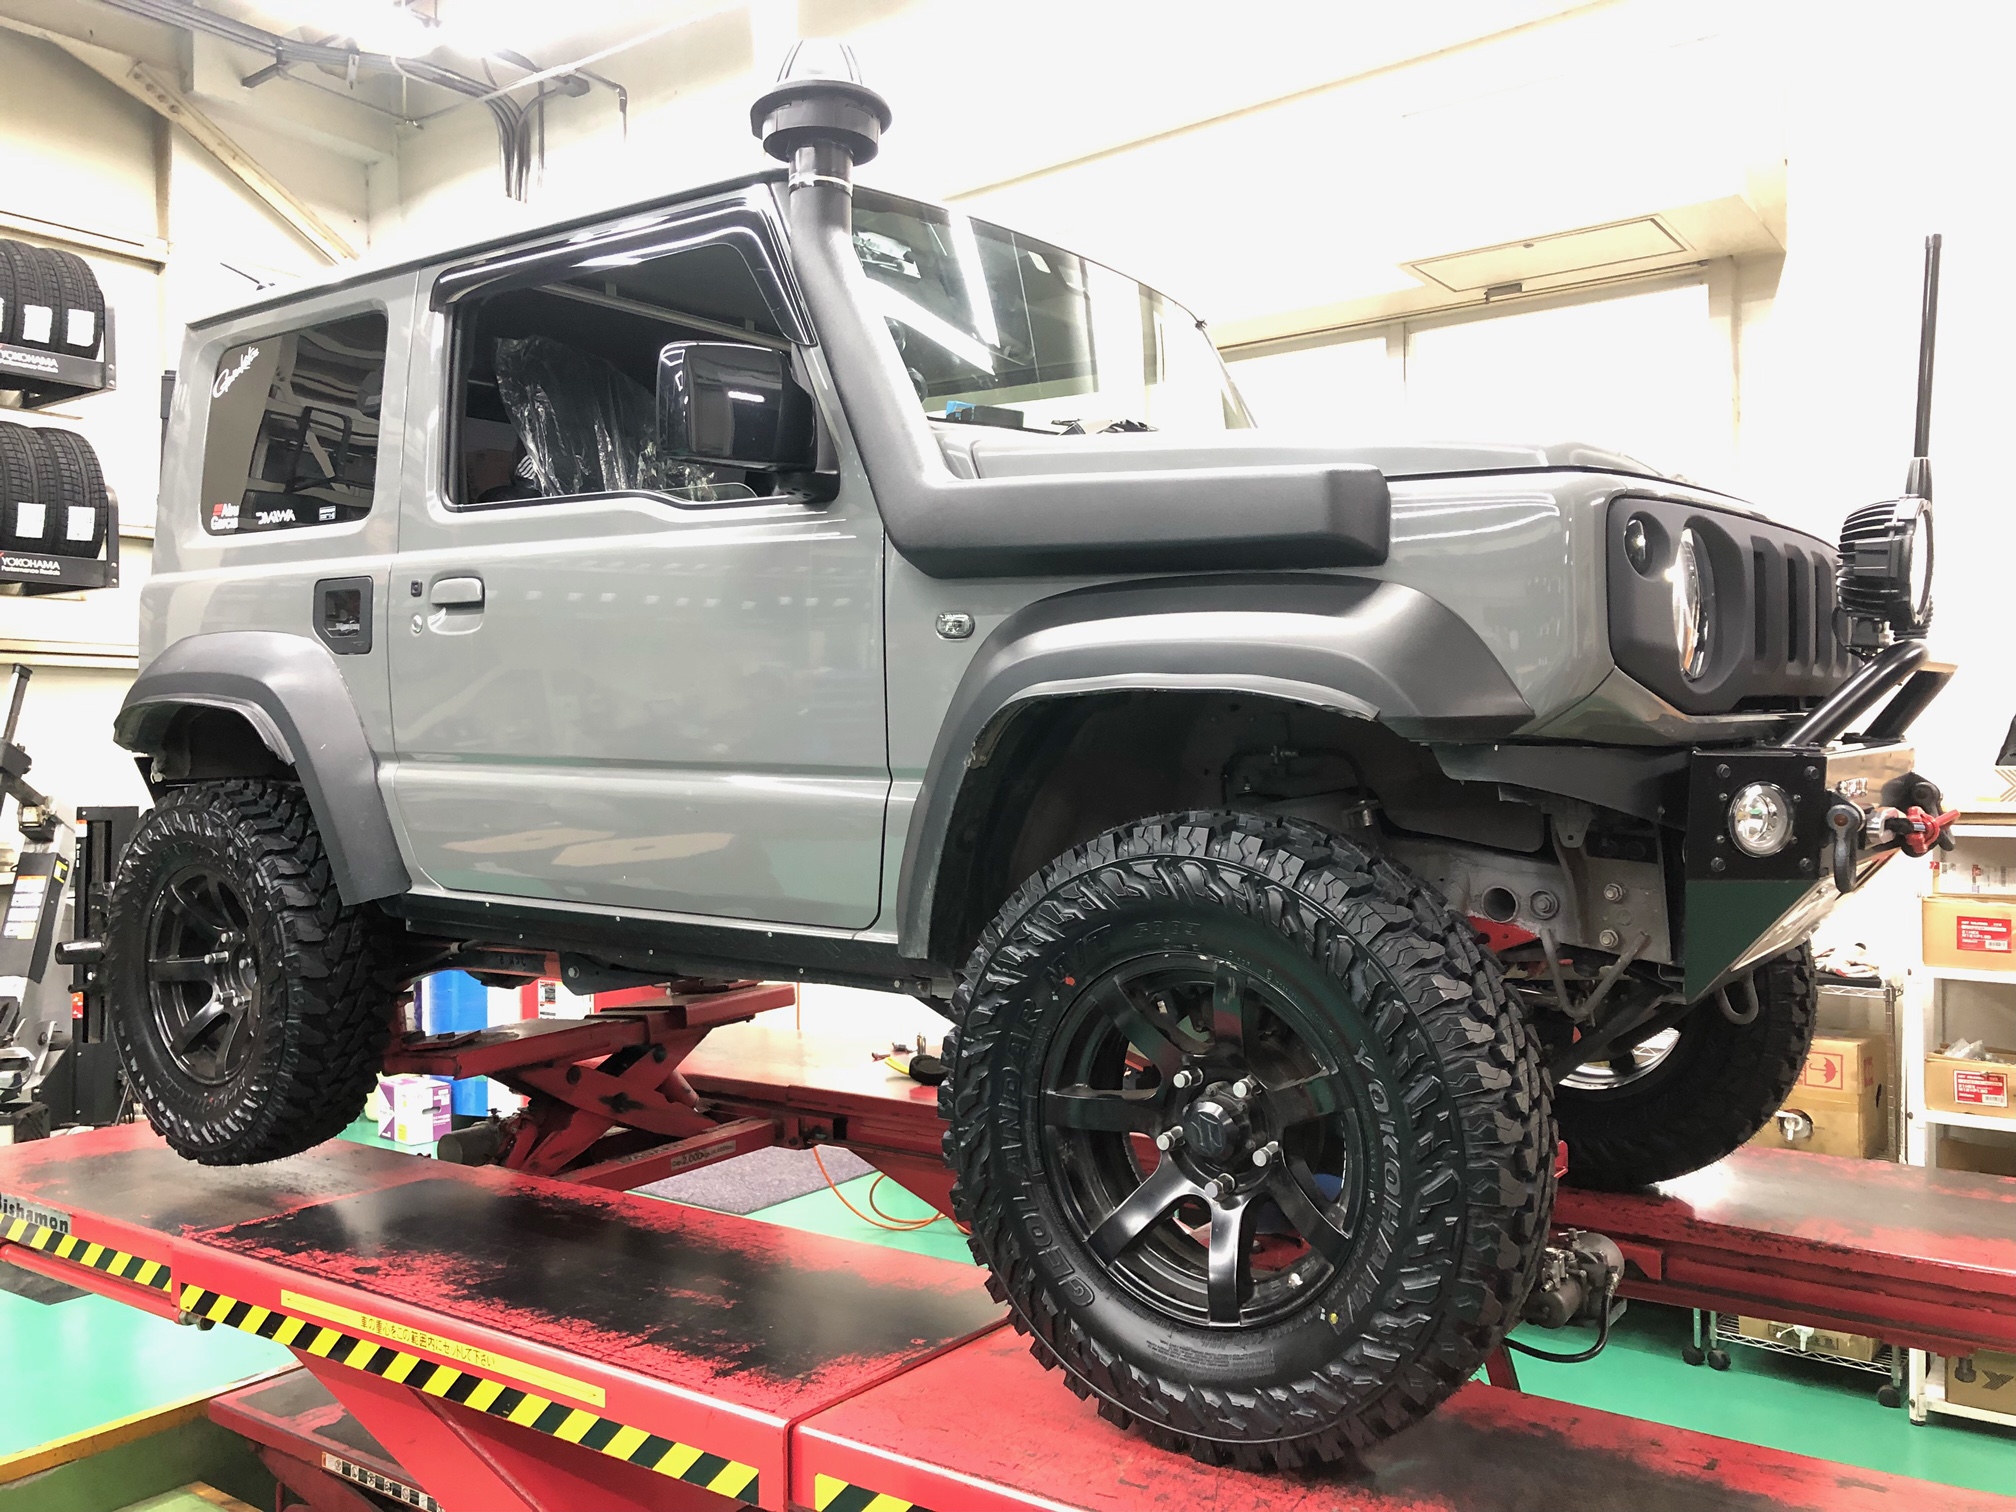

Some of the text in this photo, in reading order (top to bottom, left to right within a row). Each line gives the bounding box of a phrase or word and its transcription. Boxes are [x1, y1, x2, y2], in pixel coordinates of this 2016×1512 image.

[1, 556, 61, 571] YOKOHAMA
[998, 998, 1096, 1308] GEOLANDAR
[0, 1191, 69, 1233] ishamon
[1328, 1038, 1402, 1336] YOKOHAMA
[360, 1315, 496, 1367] 車の重心をこの範囲内にセットして下さい
